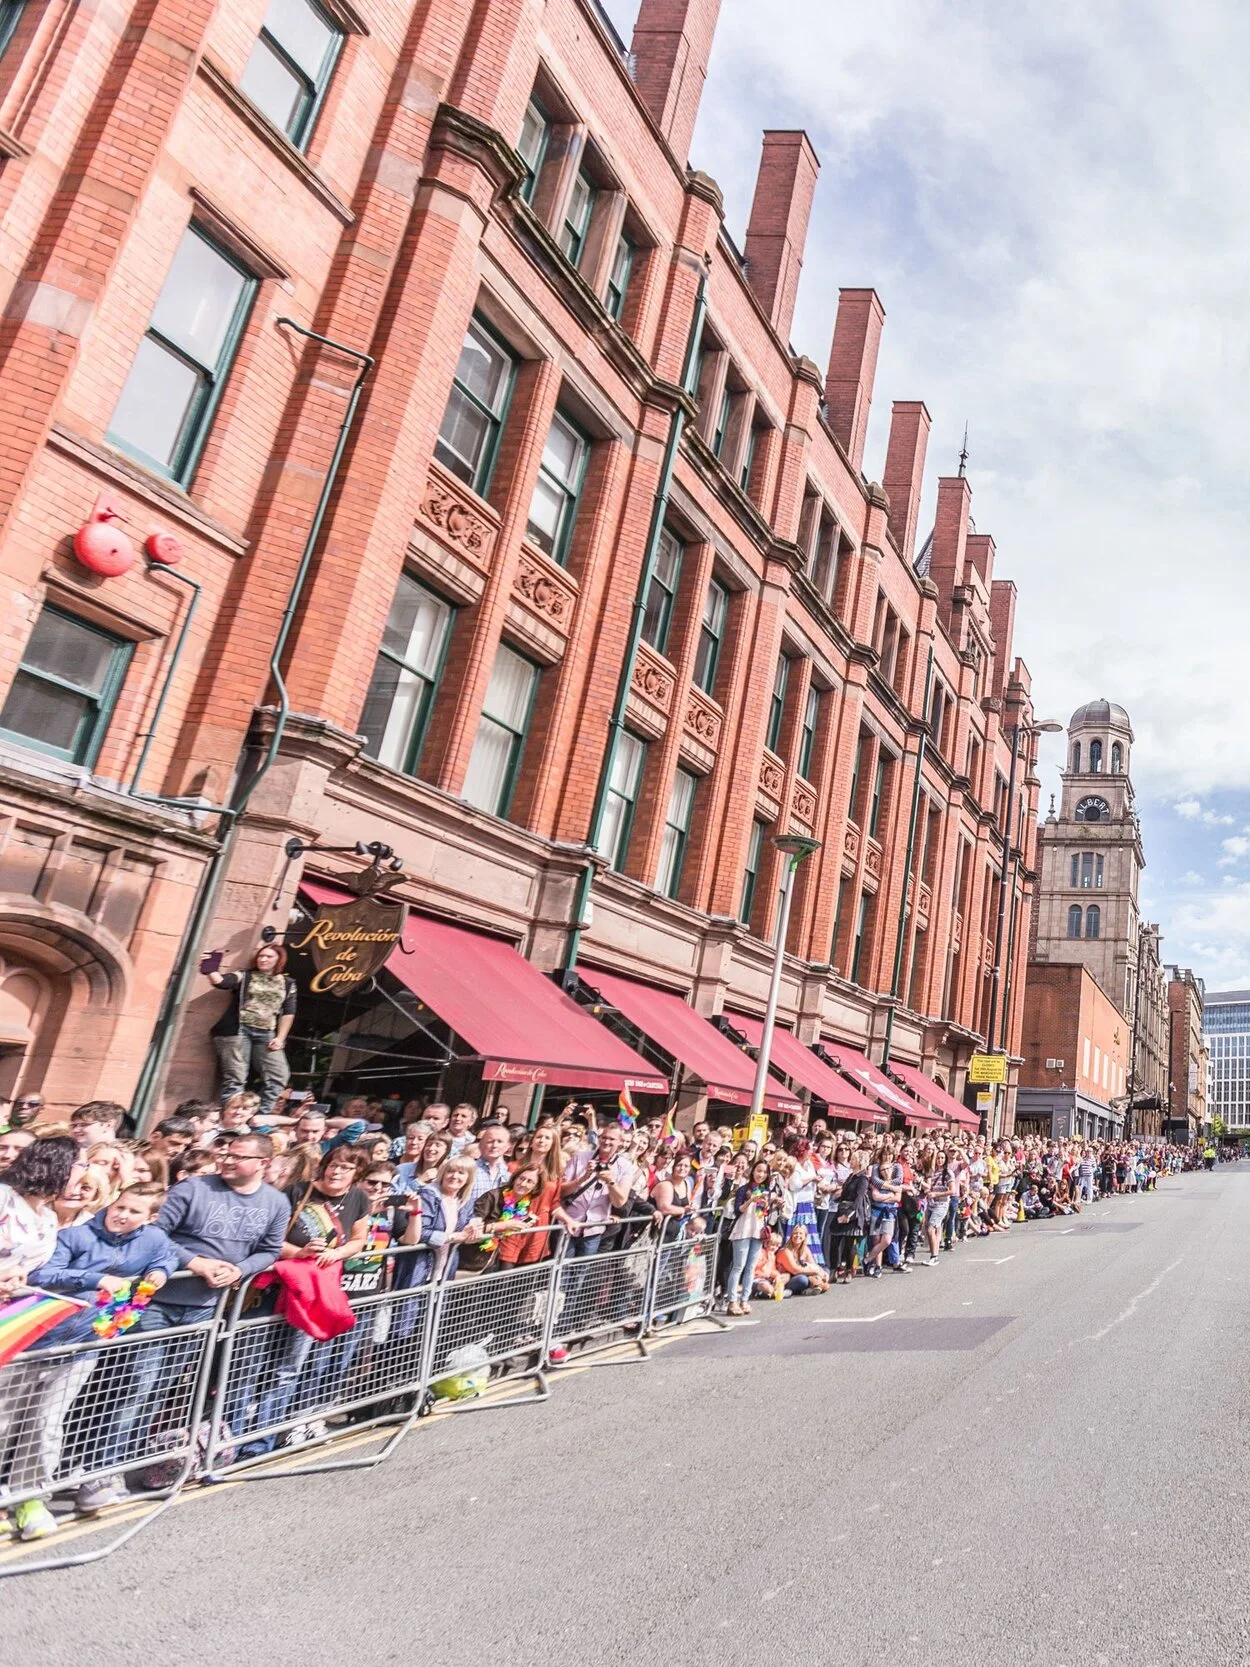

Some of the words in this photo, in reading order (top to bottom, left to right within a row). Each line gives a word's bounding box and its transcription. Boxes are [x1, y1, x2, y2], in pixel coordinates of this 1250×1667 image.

[1076, 798, 1110, 815] ALBERT
[290, 919, 400, 950] Revolución
[335, 948, 359, 962] de
[309, 964, 368, 993] Cuba
